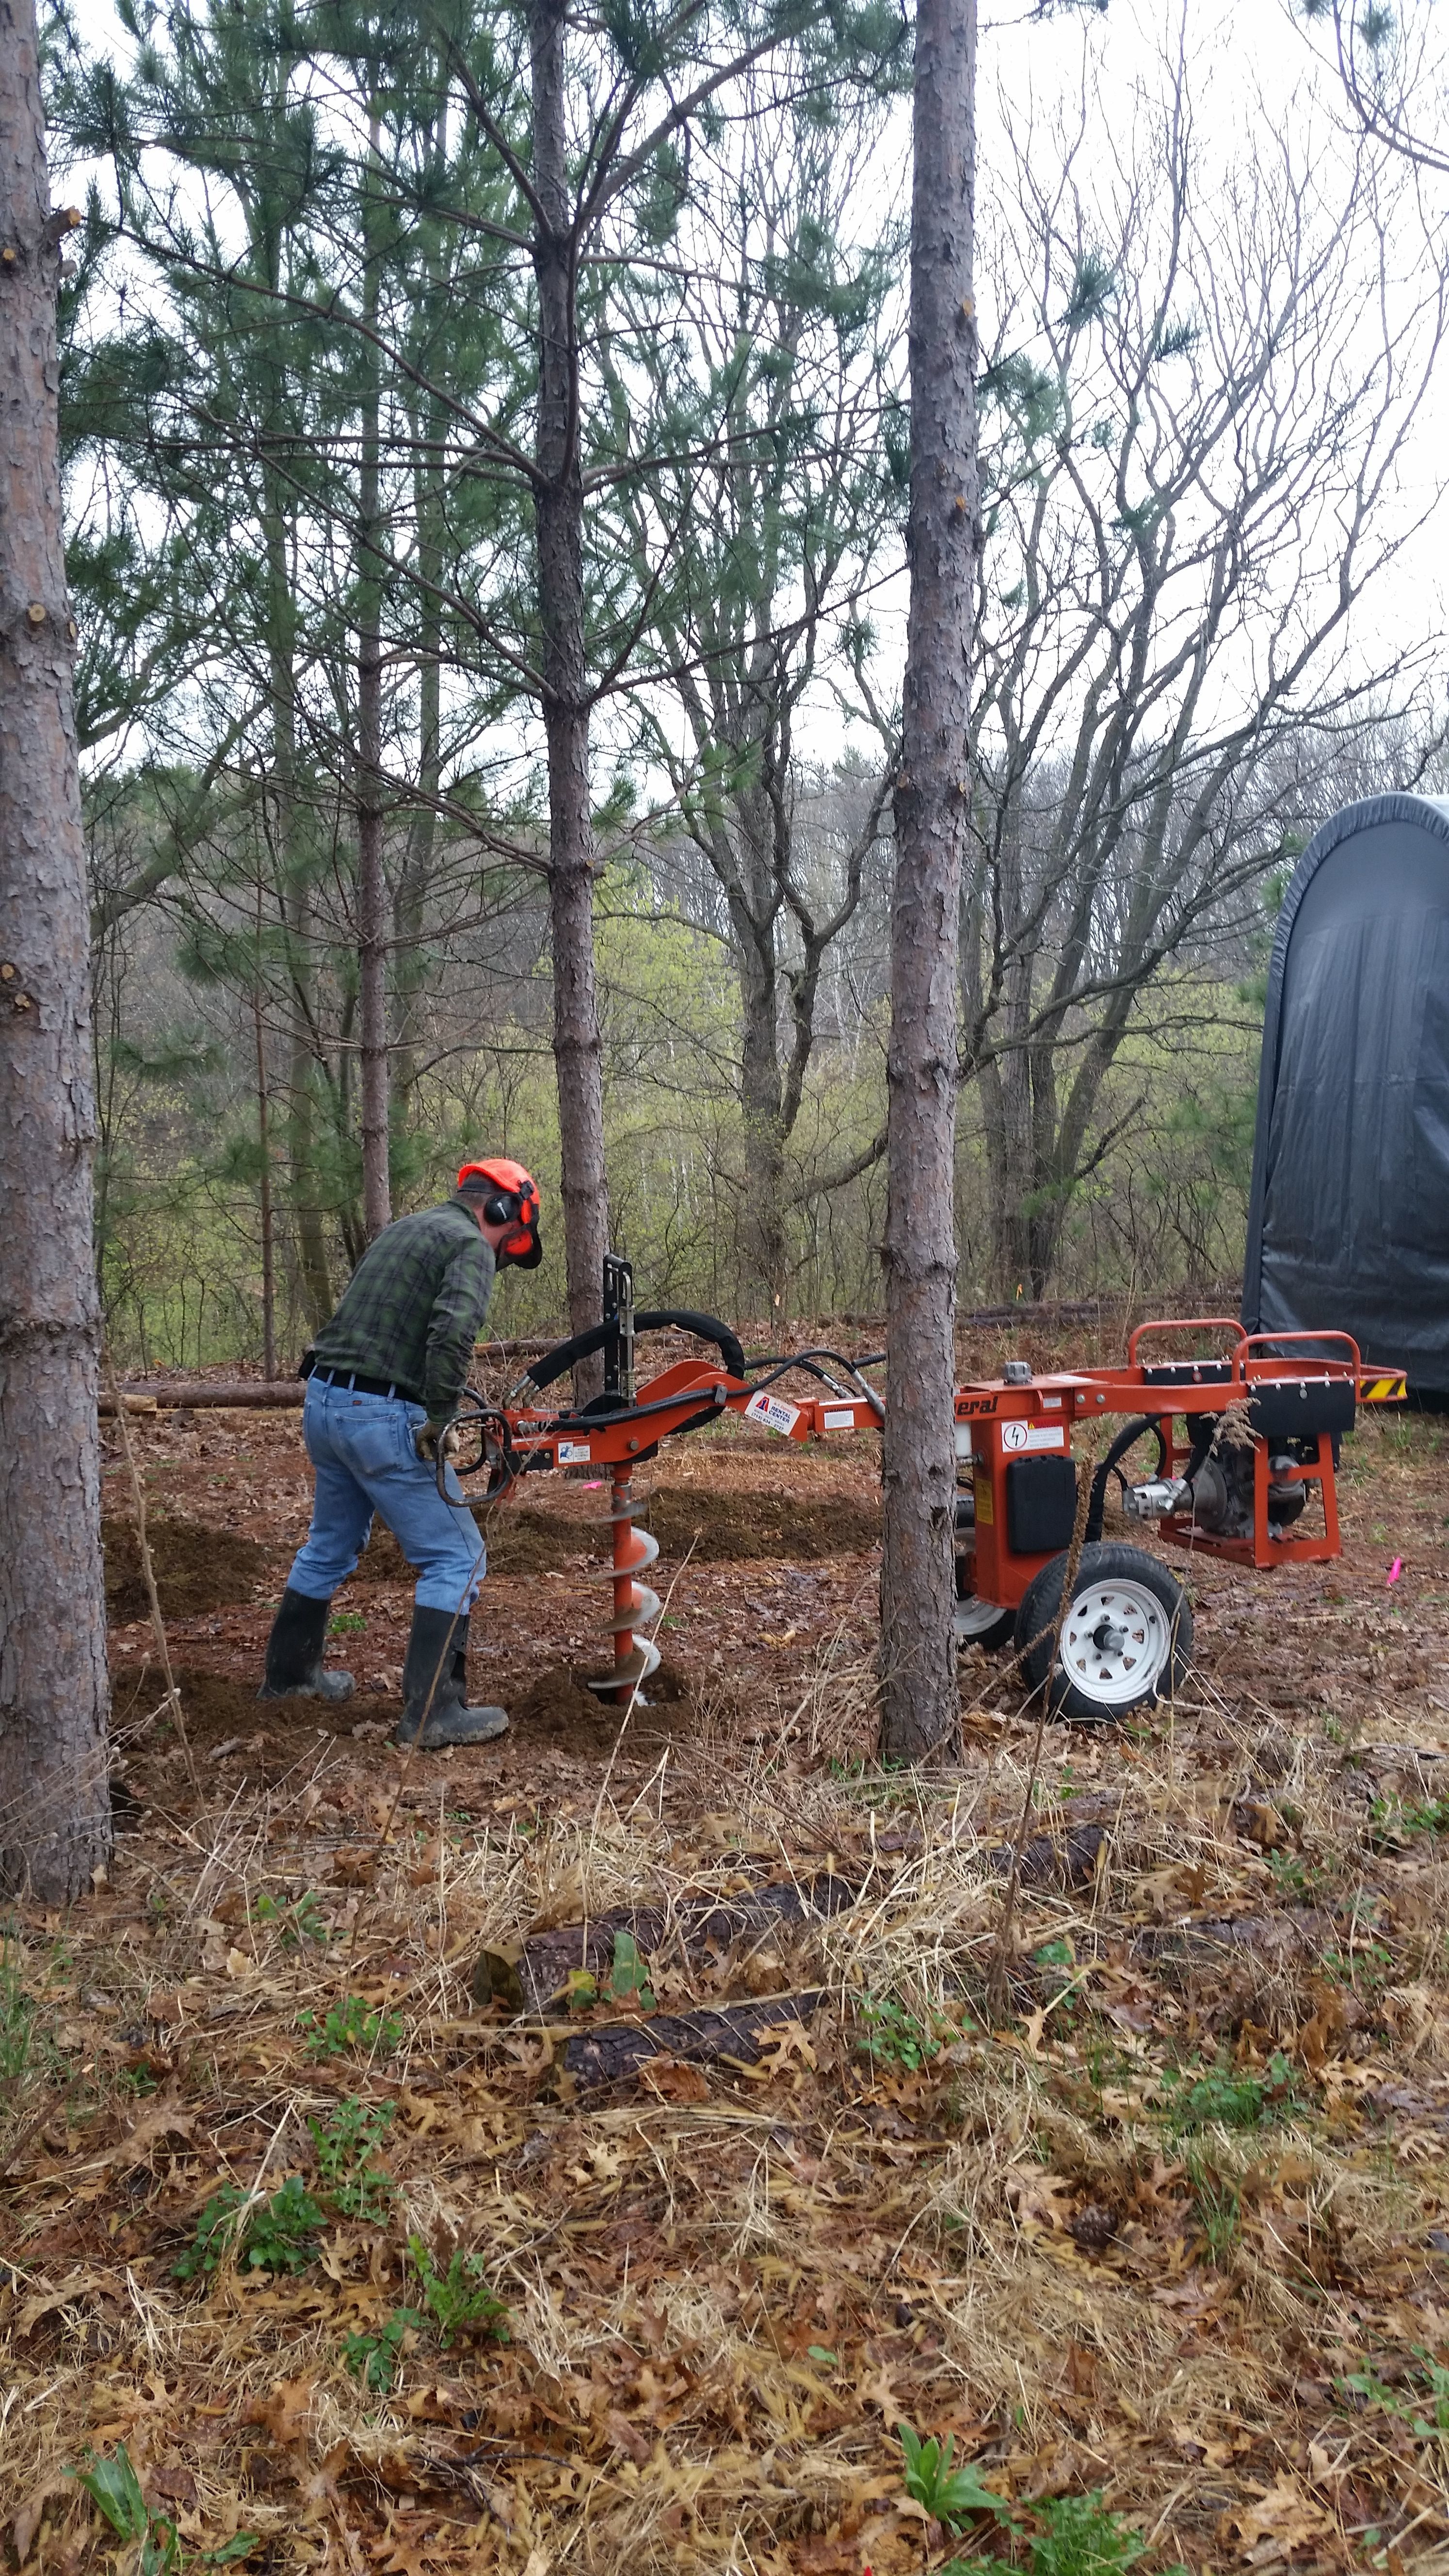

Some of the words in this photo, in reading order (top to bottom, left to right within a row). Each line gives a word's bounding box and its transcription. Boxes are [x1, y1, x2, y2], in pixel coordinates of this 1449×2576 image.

[955, 1396, 998, 1415] eral
[769, 1410, 790, 1423] CENTER
[771, 1406, 791, 1419] RENTAL
